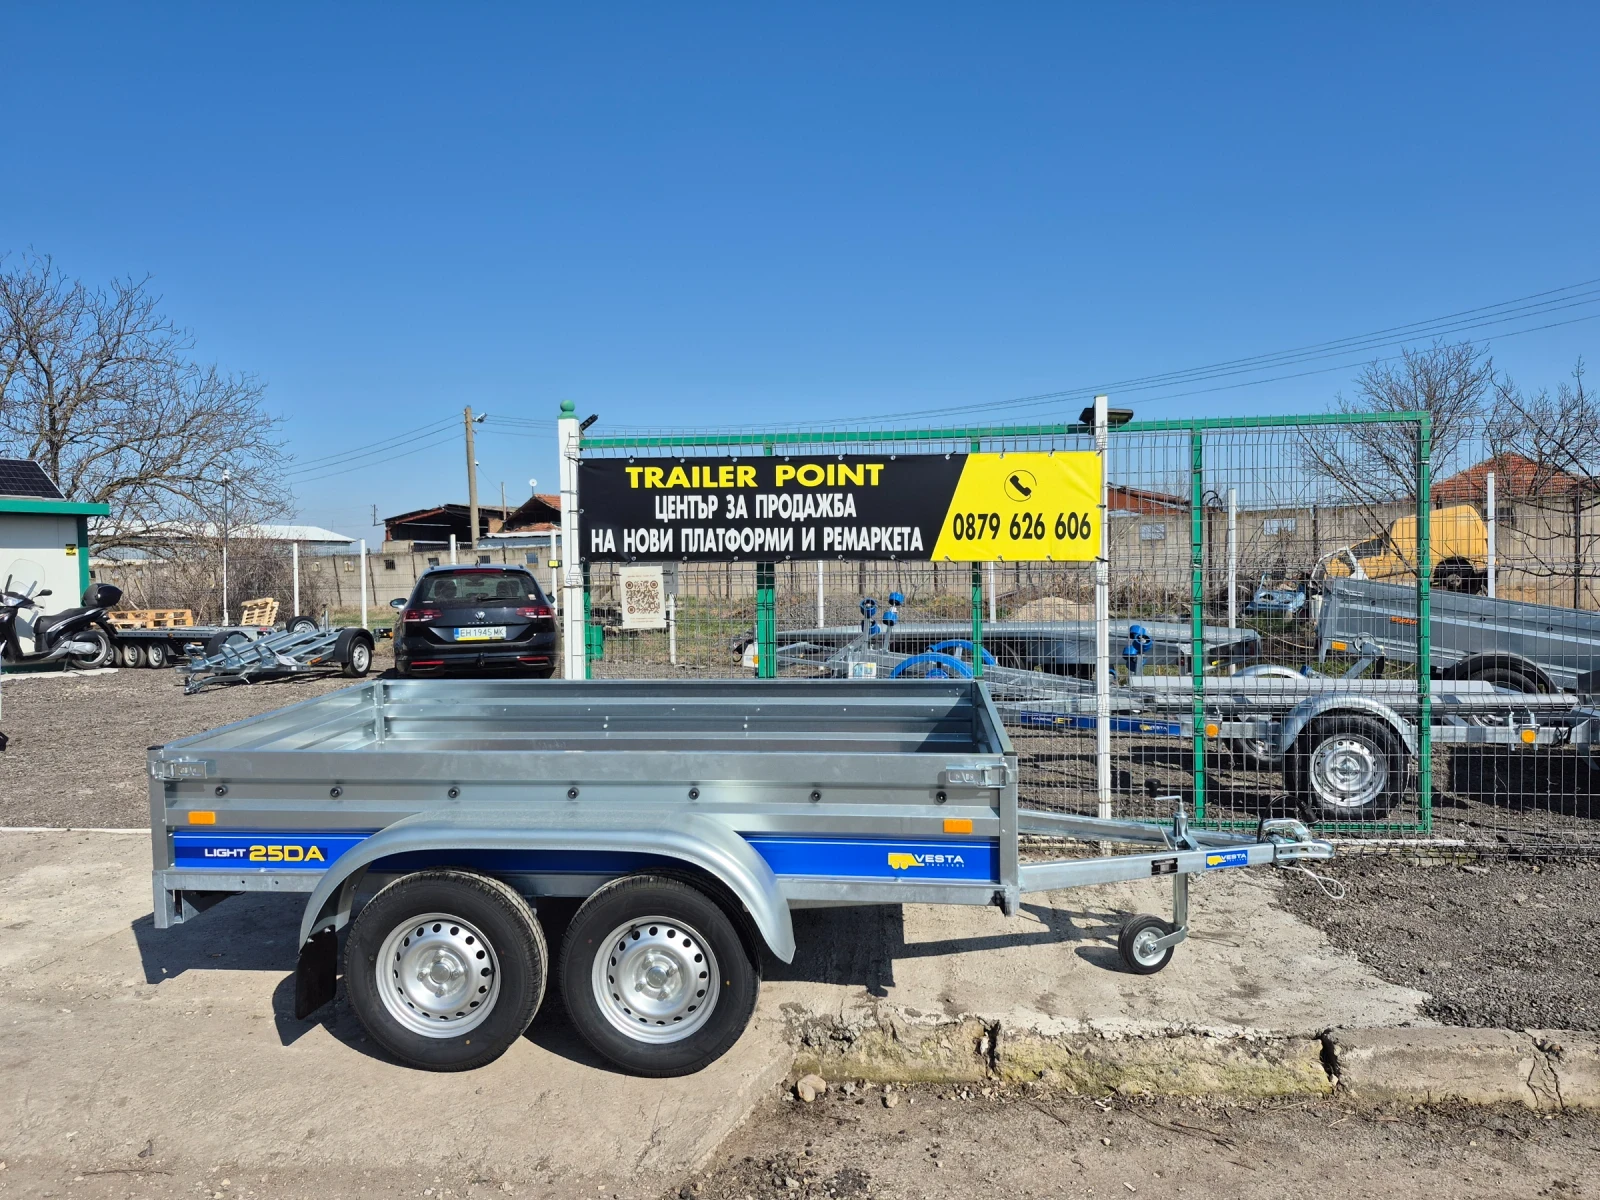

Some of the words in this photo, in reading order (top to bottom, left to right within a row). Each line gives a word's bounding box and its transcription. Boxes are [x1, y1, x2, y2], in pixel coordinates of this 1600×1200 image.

[625, 466, 758, 488] TRAILER
[775, 464, 884, 487] POINT
[655, 495, 718, 523] ЦЕНТЪР
[726, 494, 748, 519] ЗА
[755, 493, 857, 522] ПРОДАЖБА
[953, 513, 1000, 540] 0879
[1009, 512, 1045, 540] 626
[1055, 512, 1091, 540] 606
[591, 529, 616, 553] НА
[623, 528, 673, 553] НОВИ
[681, 527, 793, 553] ПЛАТФОРМИ
[802, 527, 815, 551] И
[823, 527, 924, 552] РЕМАРКЕТА
[473, 629, 492, 637] 1945
[204, 848, 246, 858] LIGHT
[249, 845, 325, 862] 25DA
[914, 854, 964, 864] VESTA
[1221, 853, 1247, 861] VESTA
